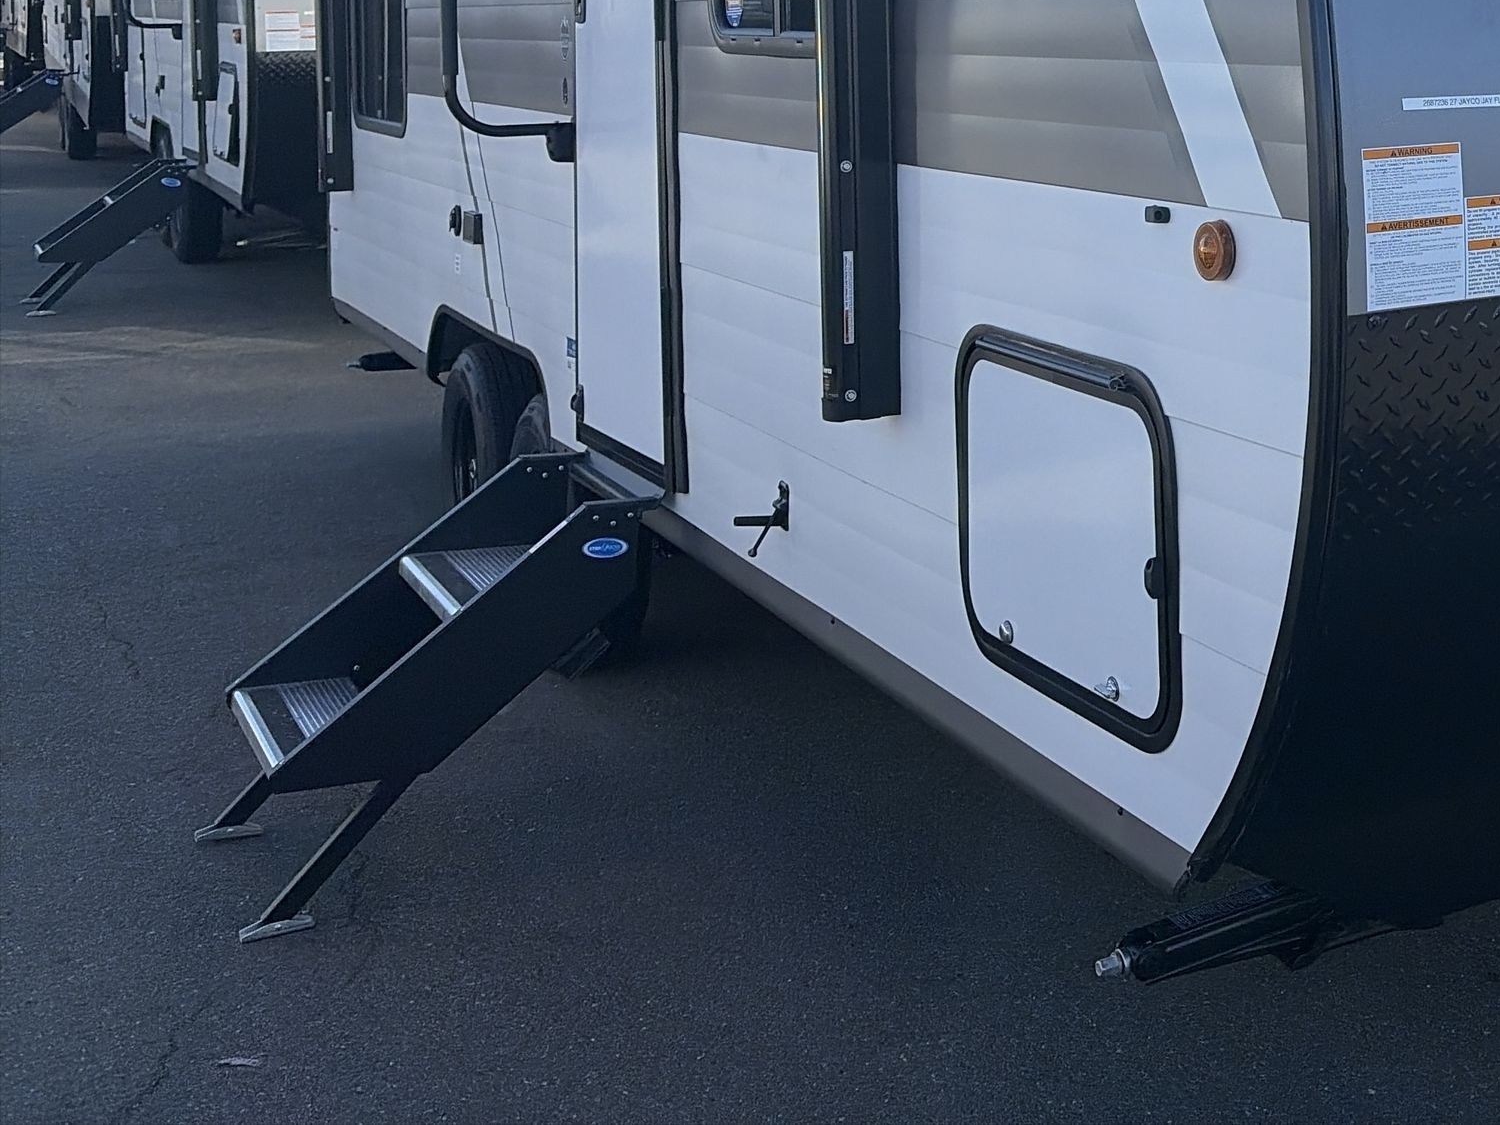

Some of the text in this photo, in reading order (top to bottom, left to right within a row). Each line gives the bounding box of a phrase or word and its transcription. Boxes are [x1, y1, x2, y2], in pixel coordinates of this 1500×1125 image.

[1458, 97, 1480, 105] JAYCO
[1481, 96, 1493, 105] JAY
[1398, 147, 1432, 157] WARNING
[1388, 217, 1448, 230] AVERTISSEMENT
